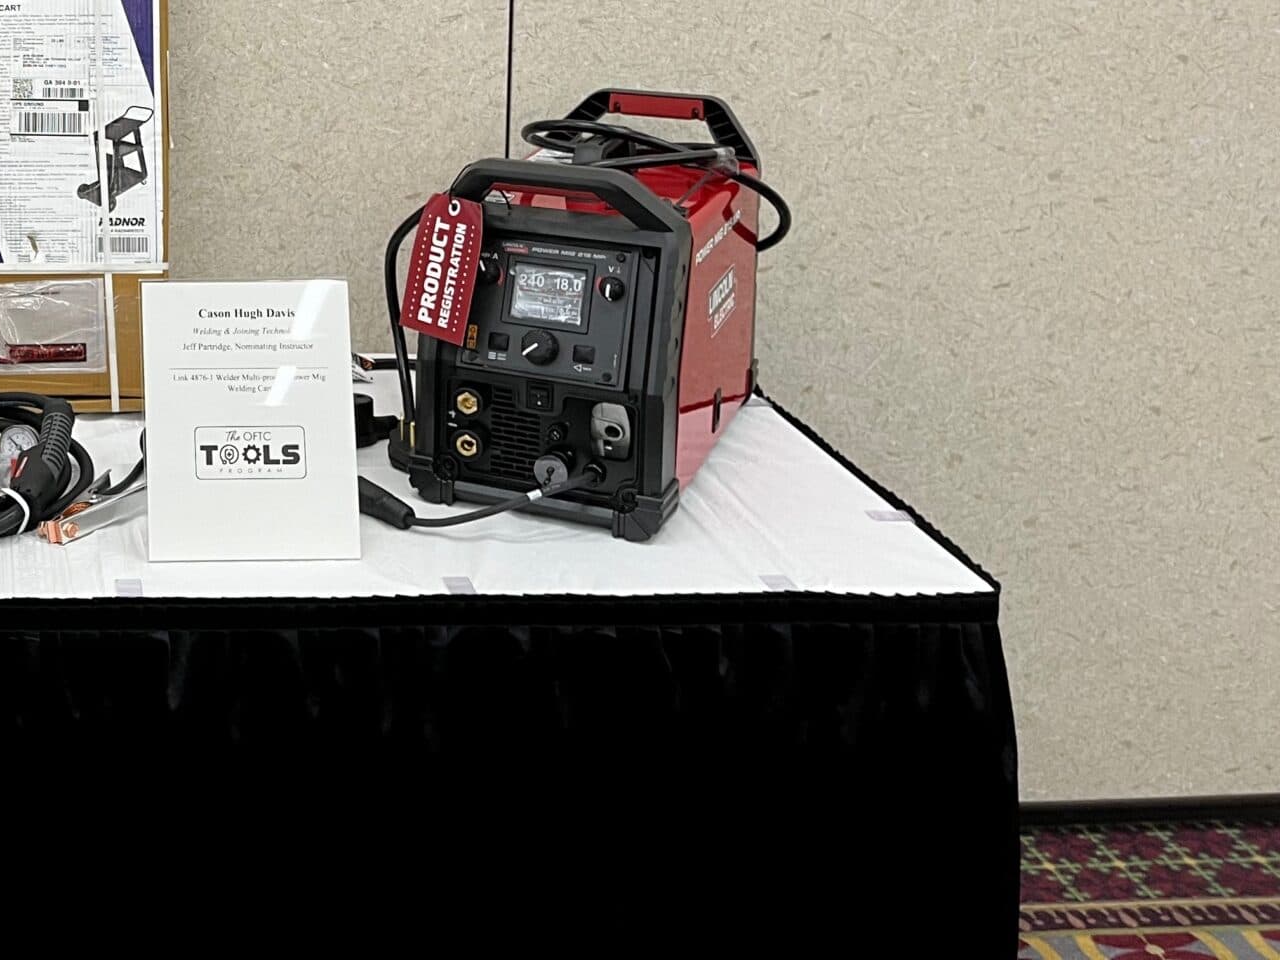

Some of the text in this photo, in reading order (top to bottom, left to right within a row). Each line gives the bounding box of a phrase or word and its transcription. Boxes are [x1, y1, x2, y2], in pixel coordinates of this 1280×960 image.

[491, 252, 499, 260] A
[417, 216, 451, 324] PRODUCT
[608, 265, 615, 273] V
[437, 222, 468, 329] REGISTRATION
[519, 273, 582, 291] 240 18.0
[198, 308, 296, 320] Cason Hugh Davis
[193, 327, 222, 336] Welding
[232, 327, 260, 336] Joining
[182, 342, 313, 351] Jeff Partridge, Nominating Instructor
[173, 374, 188, 382] Link
[215, 374, 240, 382] Welder
[311, 374, 326, 382] Mig
[227, 385, 256, 393] Welding
[225, 430, 272, 442] The OFTC
[199, 443, 301, 465] TOOLS
